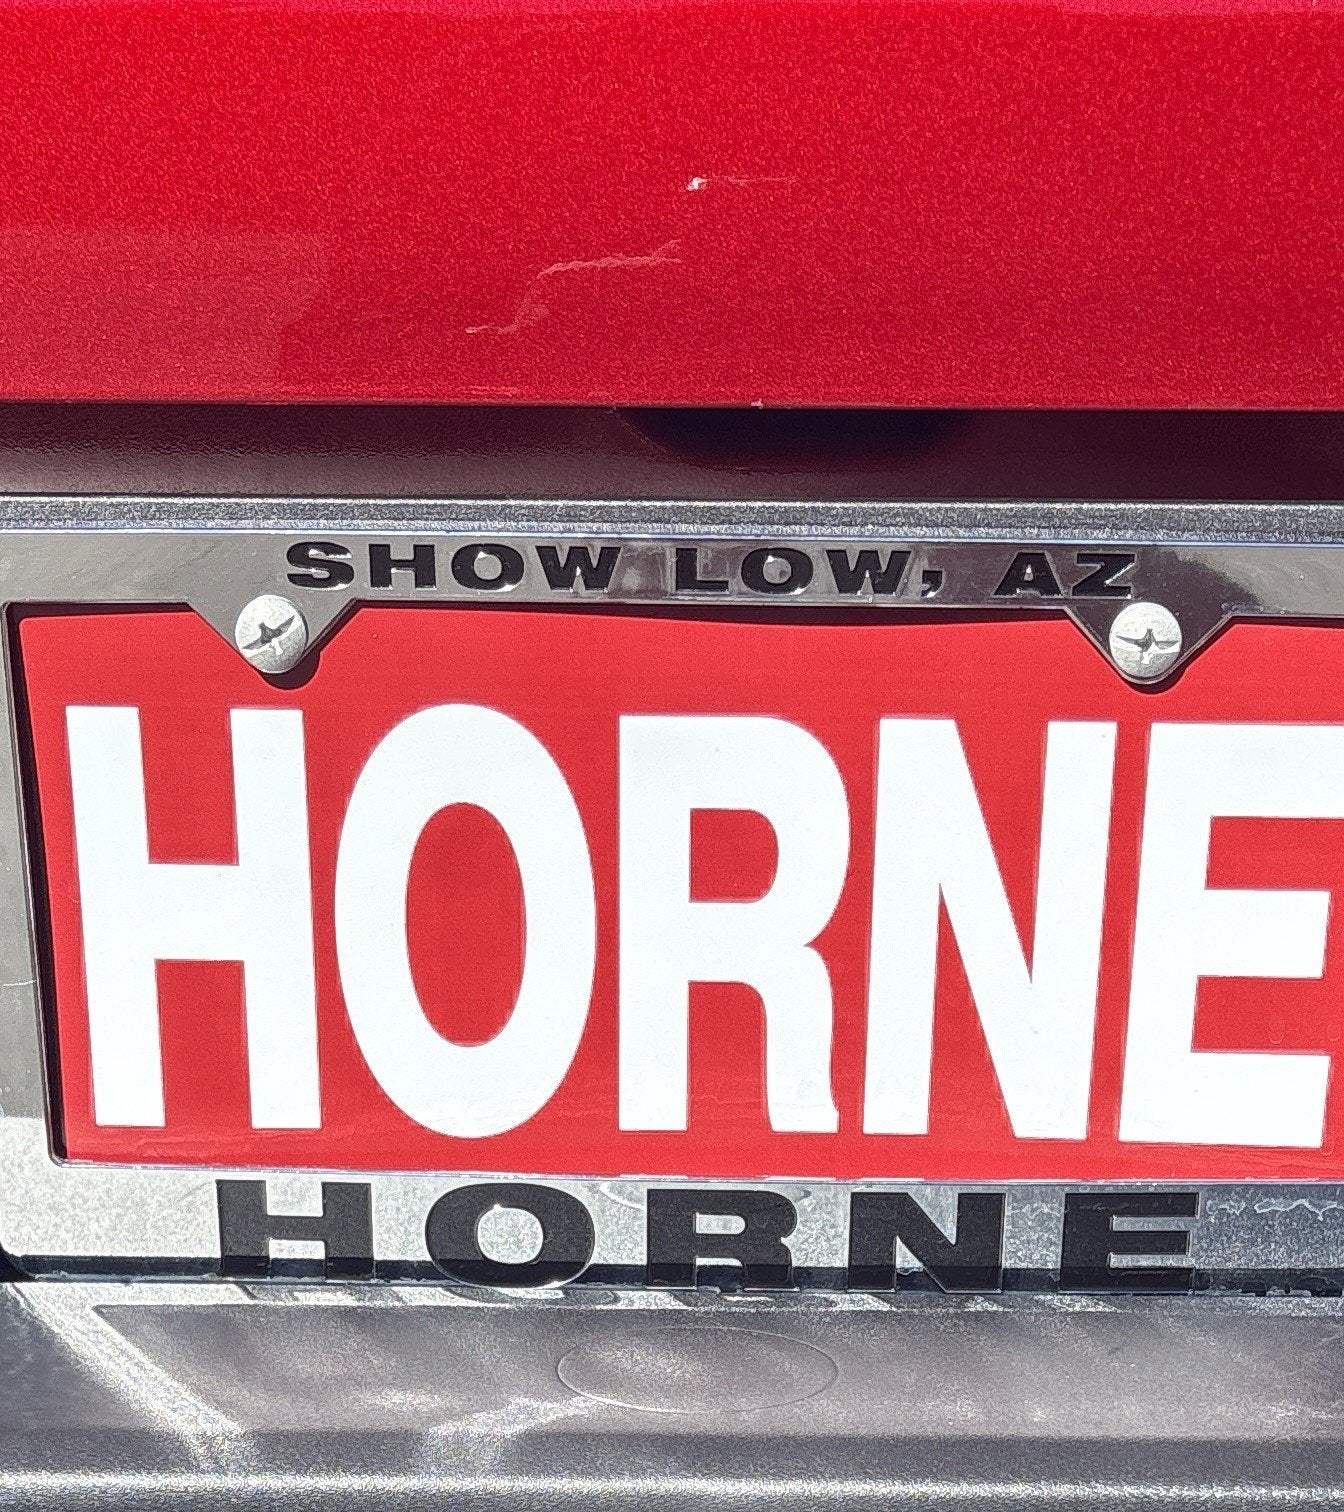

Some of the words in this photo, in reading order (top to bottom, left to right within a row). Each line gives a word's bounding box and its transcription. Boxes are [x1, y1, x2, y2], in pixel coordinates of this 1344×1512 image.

[286, 541, 622, 592] SHOW
[674, 547, 943, 598] LOW,
[992, 551, 1137, 598] AZ
[216, 1179, 1201, 1294] HORNE
